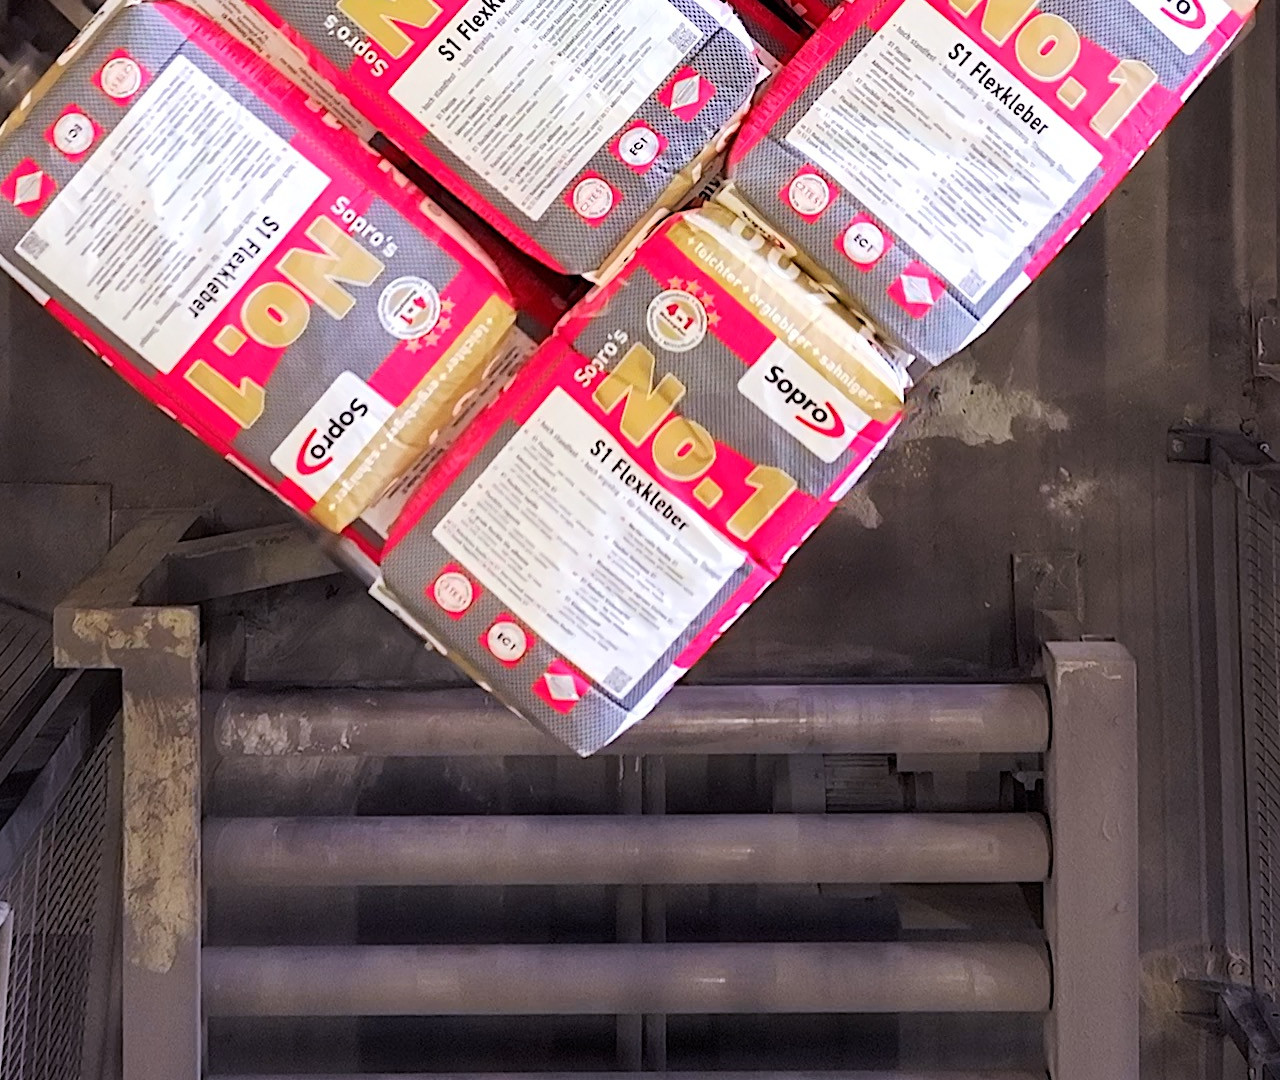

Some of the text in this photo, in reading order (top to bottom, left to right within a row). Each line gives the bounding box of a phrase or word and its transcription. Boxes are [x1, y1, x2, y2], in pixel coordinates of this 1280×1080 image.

[323, 14, 389, 78] Sopro's
[437, 37, 462, 61] S1
[948, 42, 1049, 135] S1 Flexkleber
[330, 195, 398, 258] Sopro's
[188, 215, 279, 318] S1 Flexkleber
[184, 215, 386, 430] No.1
[664, 300, 680, 316] 4
[694, 241, 747, 286] leichter
[819, 353, 873, 401] sahniger
[445, 324, 489, 373] leichter
[573, 328, 628, 388] Sopro's
[302, 397, 368, 466] Sopro
[764, 365, 833, 431] Sopro
[592, 342, 797, 542] No.1
[590, 439, 687, 530] S1 Flexkleber
